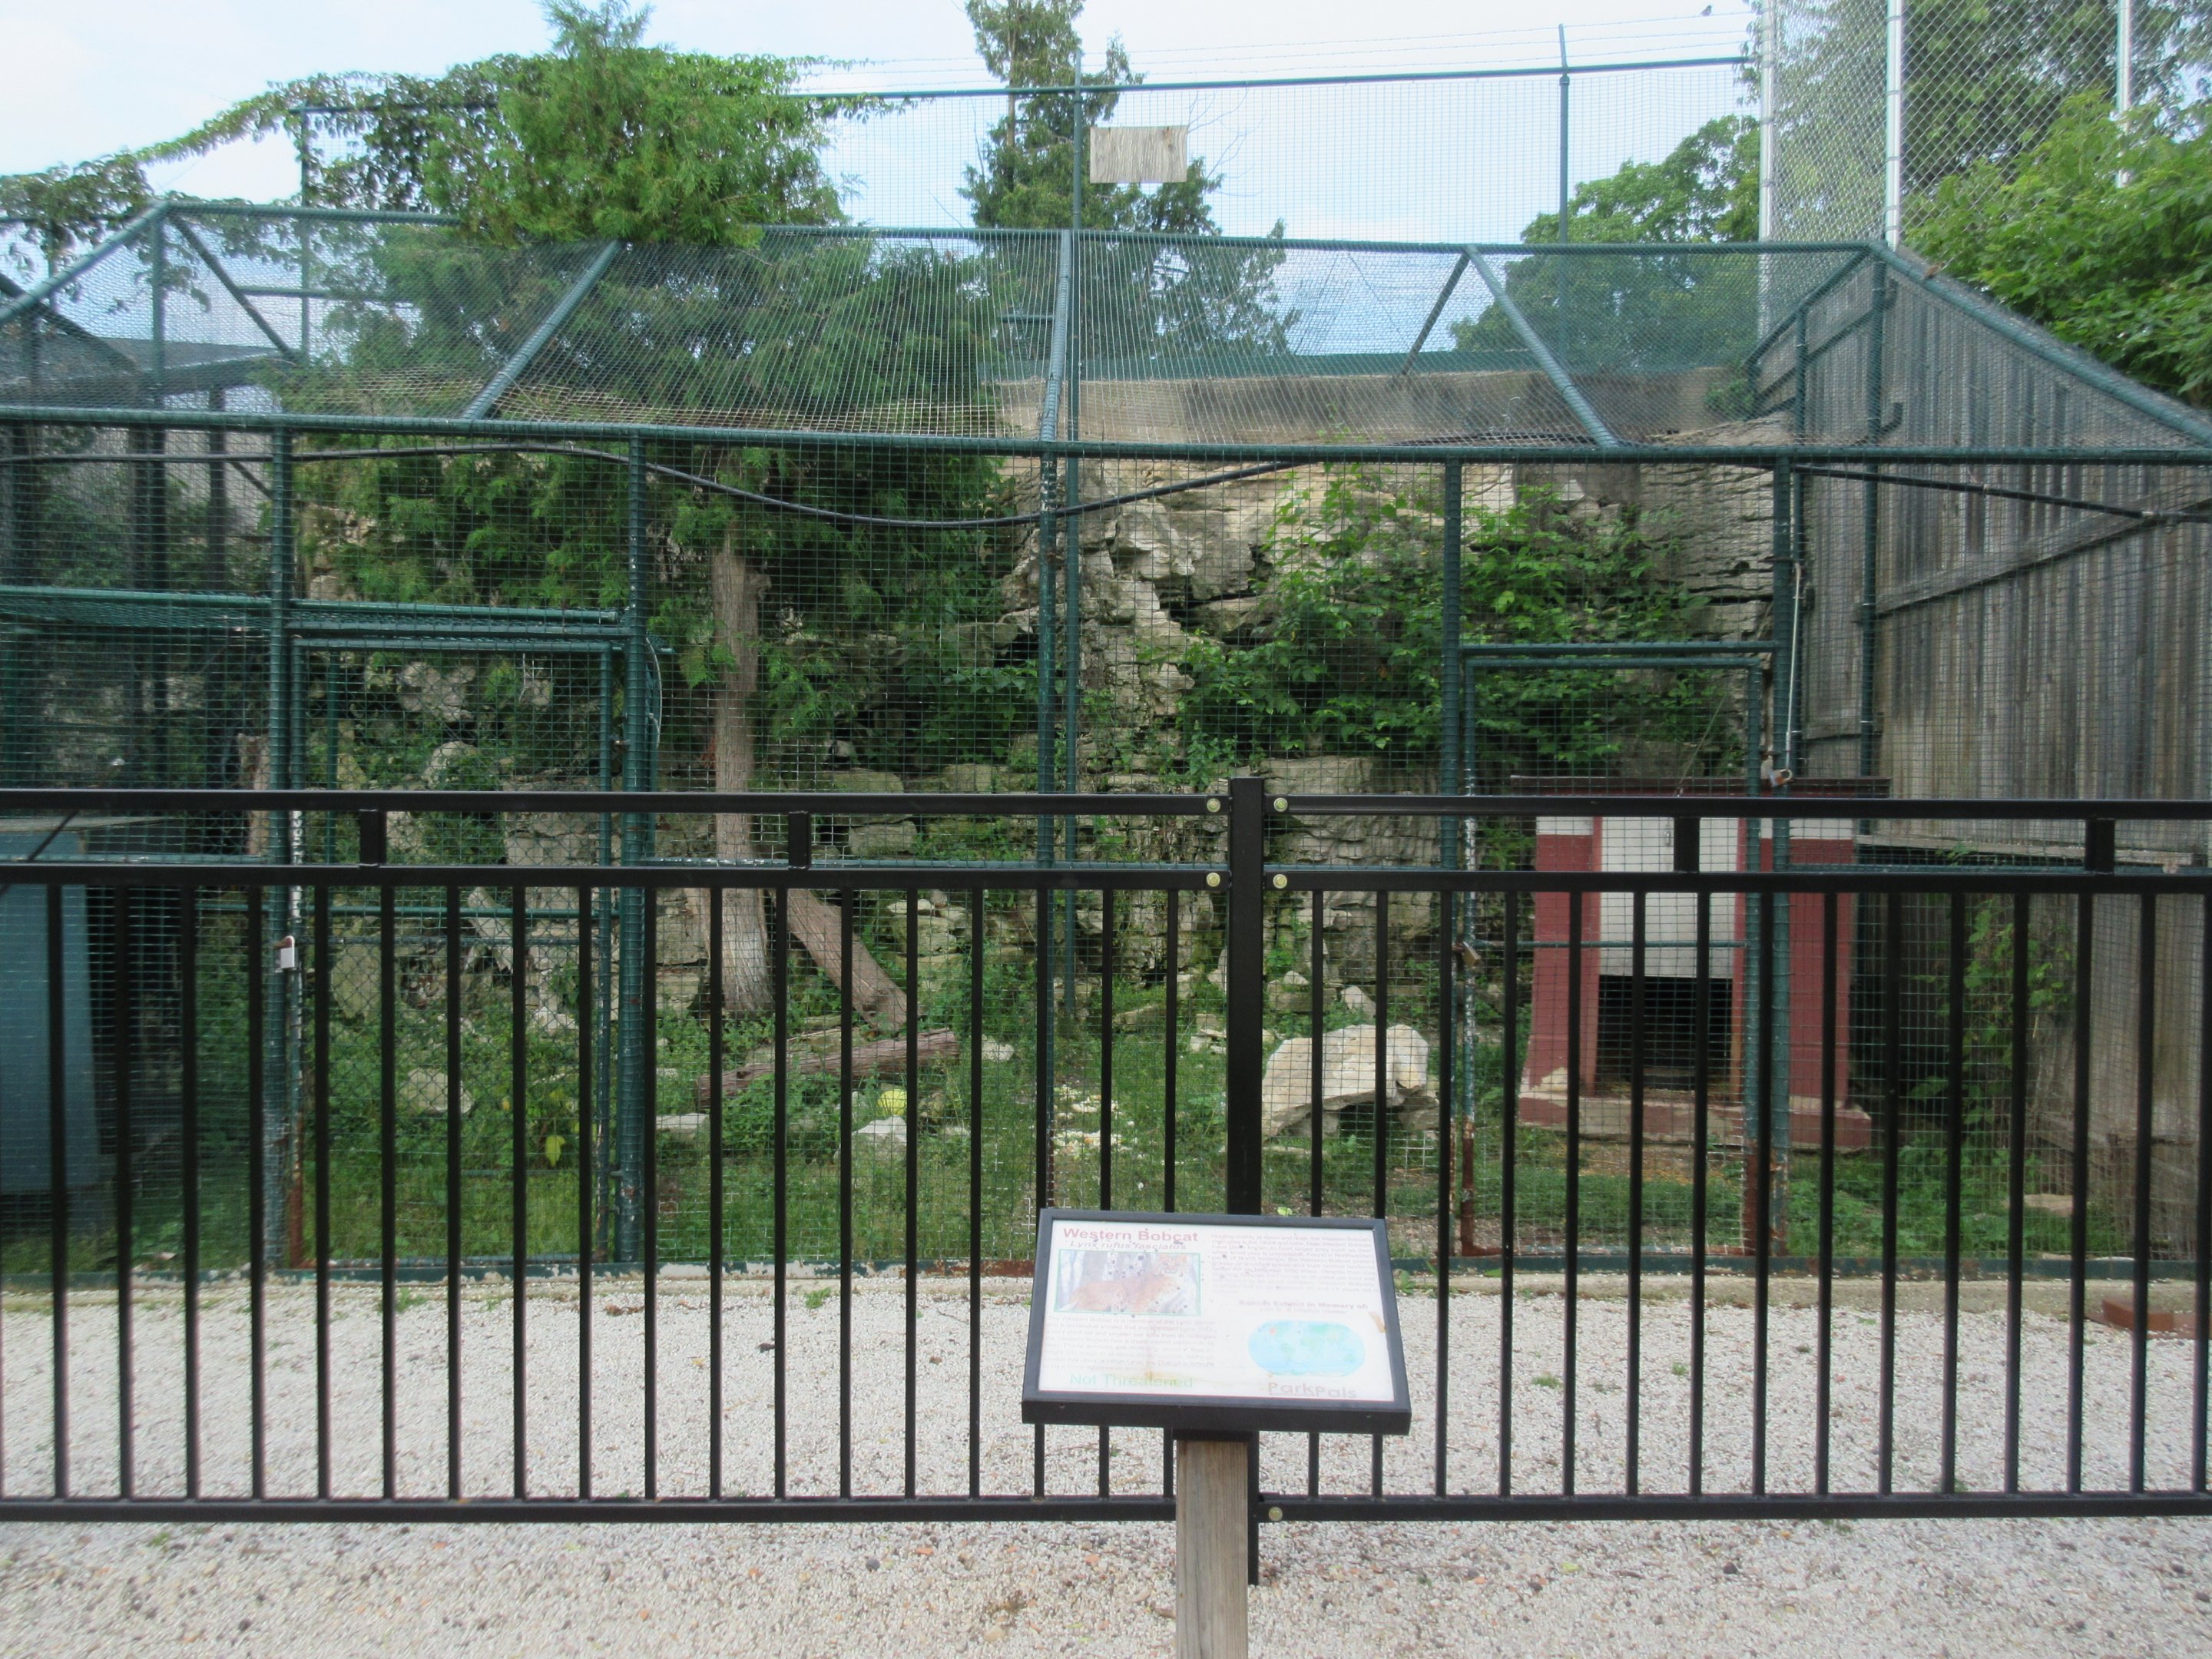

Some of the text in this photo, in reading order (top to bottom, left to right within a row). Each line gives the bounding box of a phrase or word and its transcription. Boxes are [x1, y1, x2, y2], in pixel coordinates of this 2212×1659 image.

[1063, 1228, 1131, 1240] Western
[1138, 1230, 1199, 1243] Bobcat
[1069, 1240, 1098, 1249] Lynx
[1133, 1242, 1187, 1250] fasciatus
[1070, 1373, 1193, 1387] Not Threatened
[1268, 1381, 1357, 1398] ParkPals
